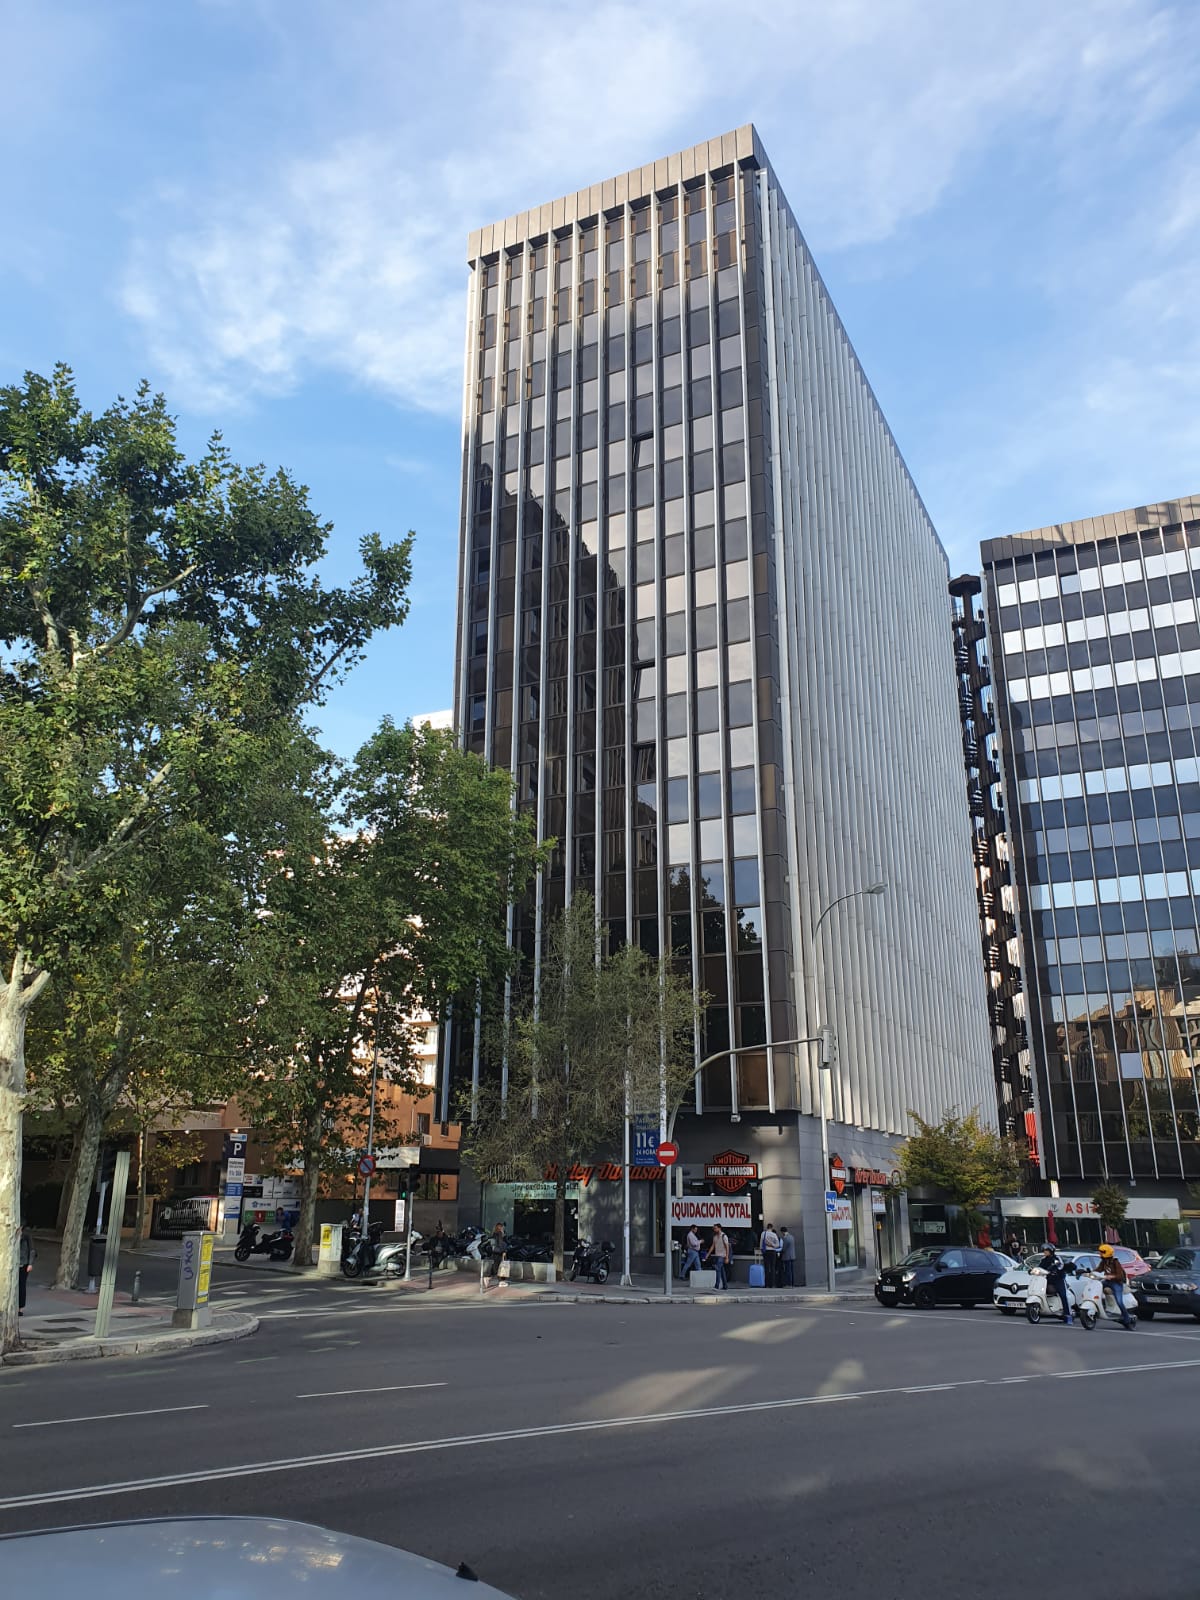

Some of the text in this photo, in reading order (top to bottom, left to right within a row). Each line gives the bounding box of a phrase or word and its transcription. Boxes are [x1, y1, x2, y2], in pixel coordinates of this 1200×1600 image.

[636, 1132, 655, 1149] 11€
[233, 1142, 242, 1156] P
[707, 1166, 754, 1176] HARLEY-DAVIDSON
[671, 1202, 751, 1221] IQUIDACION TOTAL
